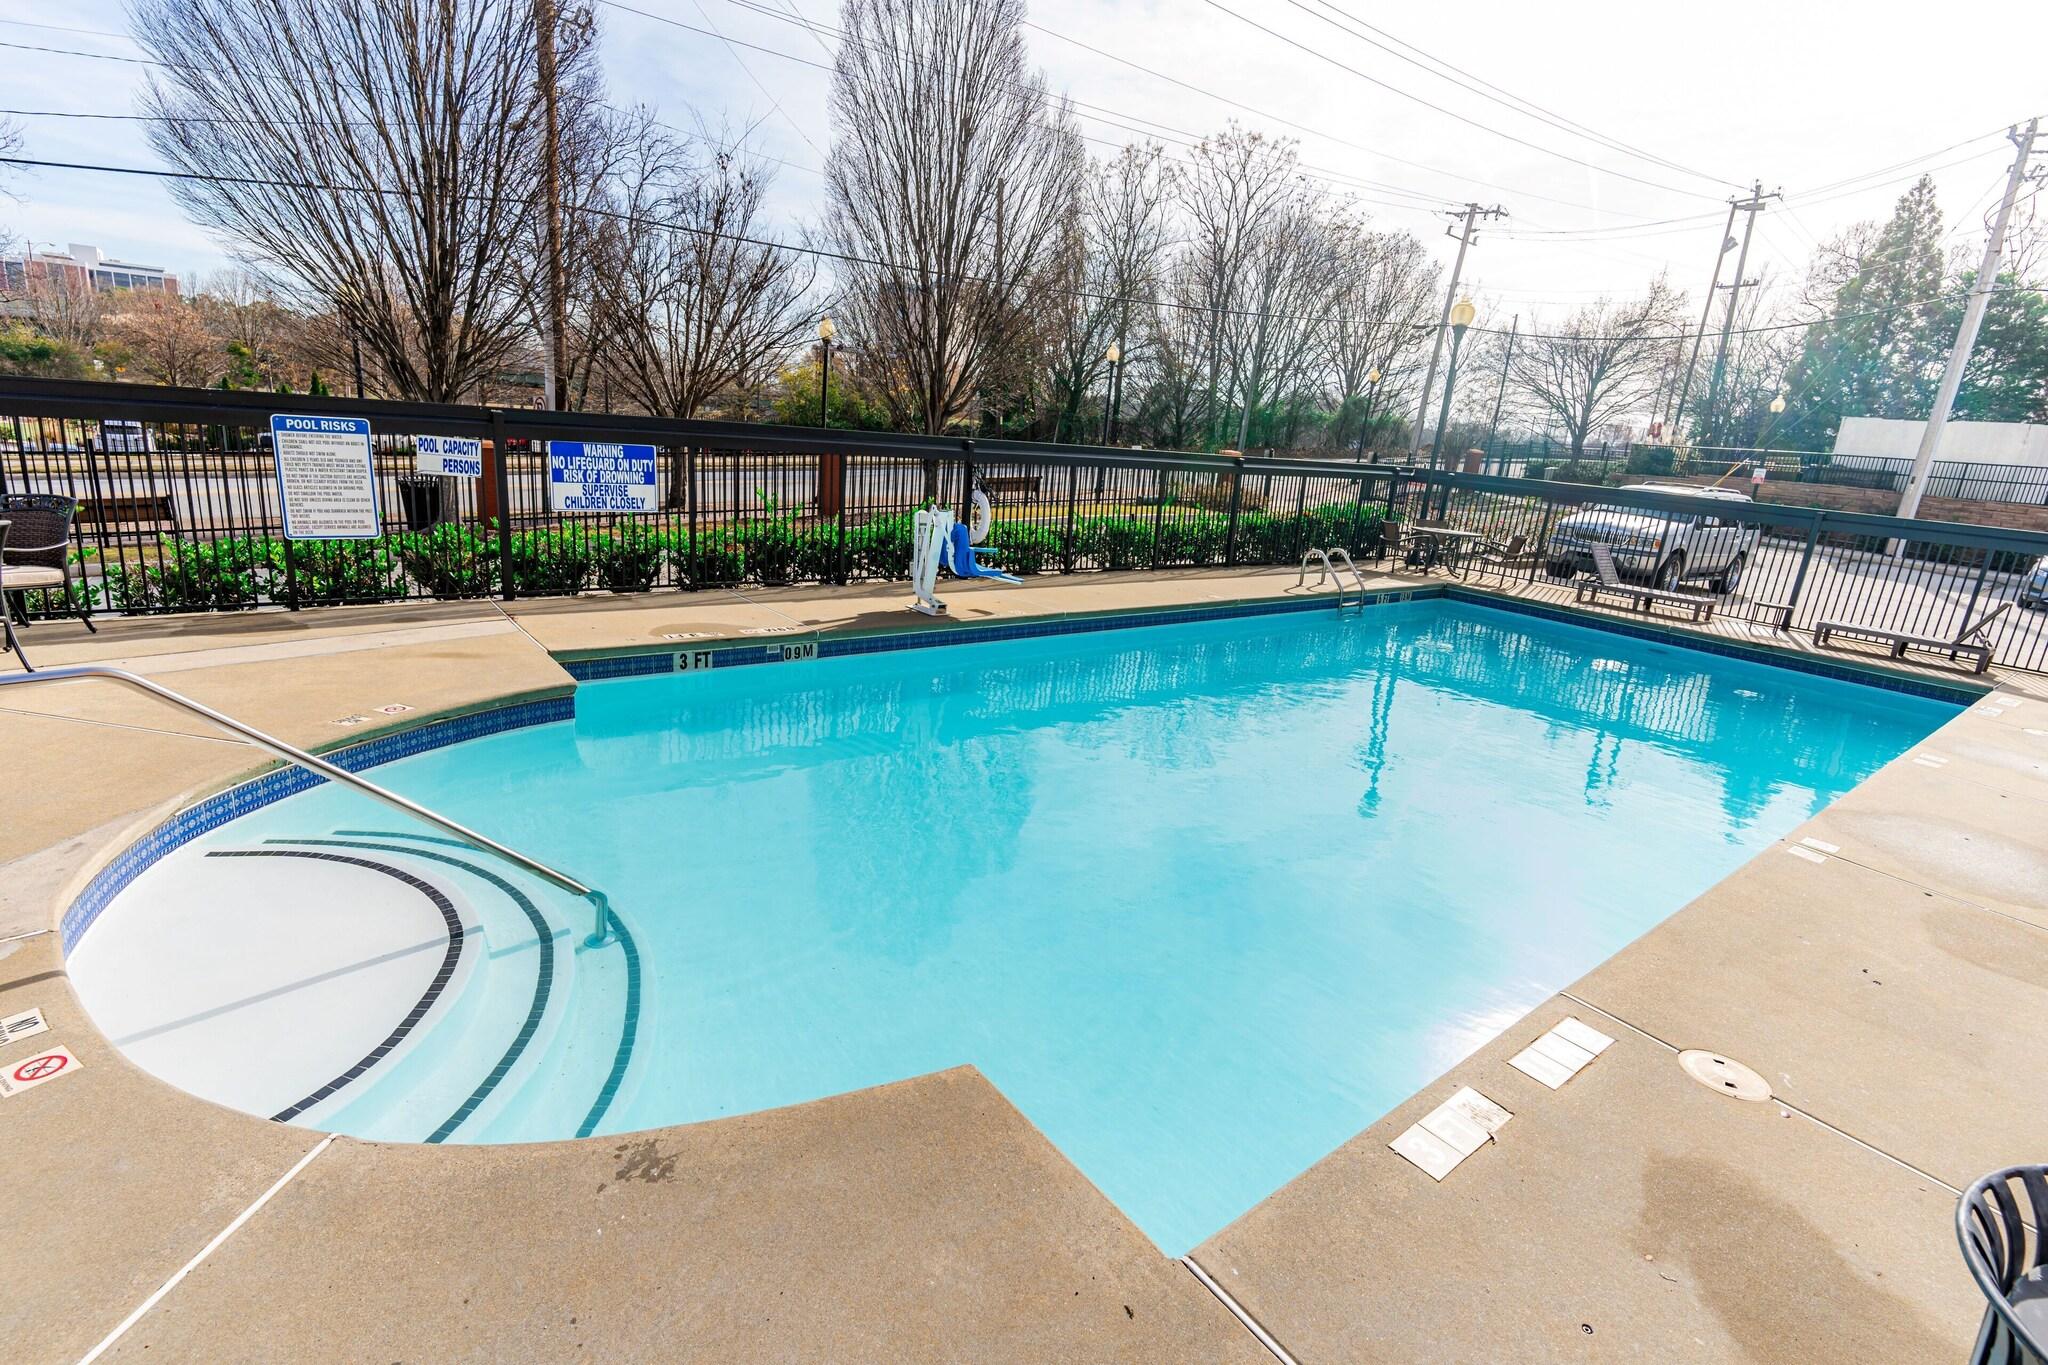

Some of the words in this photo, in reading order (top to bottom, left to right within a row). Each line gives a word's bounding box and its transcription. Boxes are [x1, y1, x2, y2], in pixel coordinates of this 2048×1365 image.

[286, 419, 318, 430] POOL
[321, 421, 356, 432] RISKS
[418, 437, 439, 453] POOL
[443, 439, 479, 456] CAPACITY
[583, 443, 624, 457] WARNING
[442, 458, 480, 475] PERSONS
[552, 456, 566, 469] NO
[568, 457, 616, 471] LIFEGUARD
[617, 458, 630, 471] ON
[631, 459, 653, 472] DUTY
[563, 470, 583, 482] RISK
[585, 471, 598, 483] OF
[599, 471, 645, 484] DROWNING
[582, 484, 628, 497] SUPERVISE
[564, 495, 608, 508] CHILDREN
[609, 497, 646, 510] CLOSELY
[785, 646, 801, 660] 0.9
[803, 644, 813, 657] M
[679, 654, 687, 670] 3
[694, 652, 711, 668] FT
